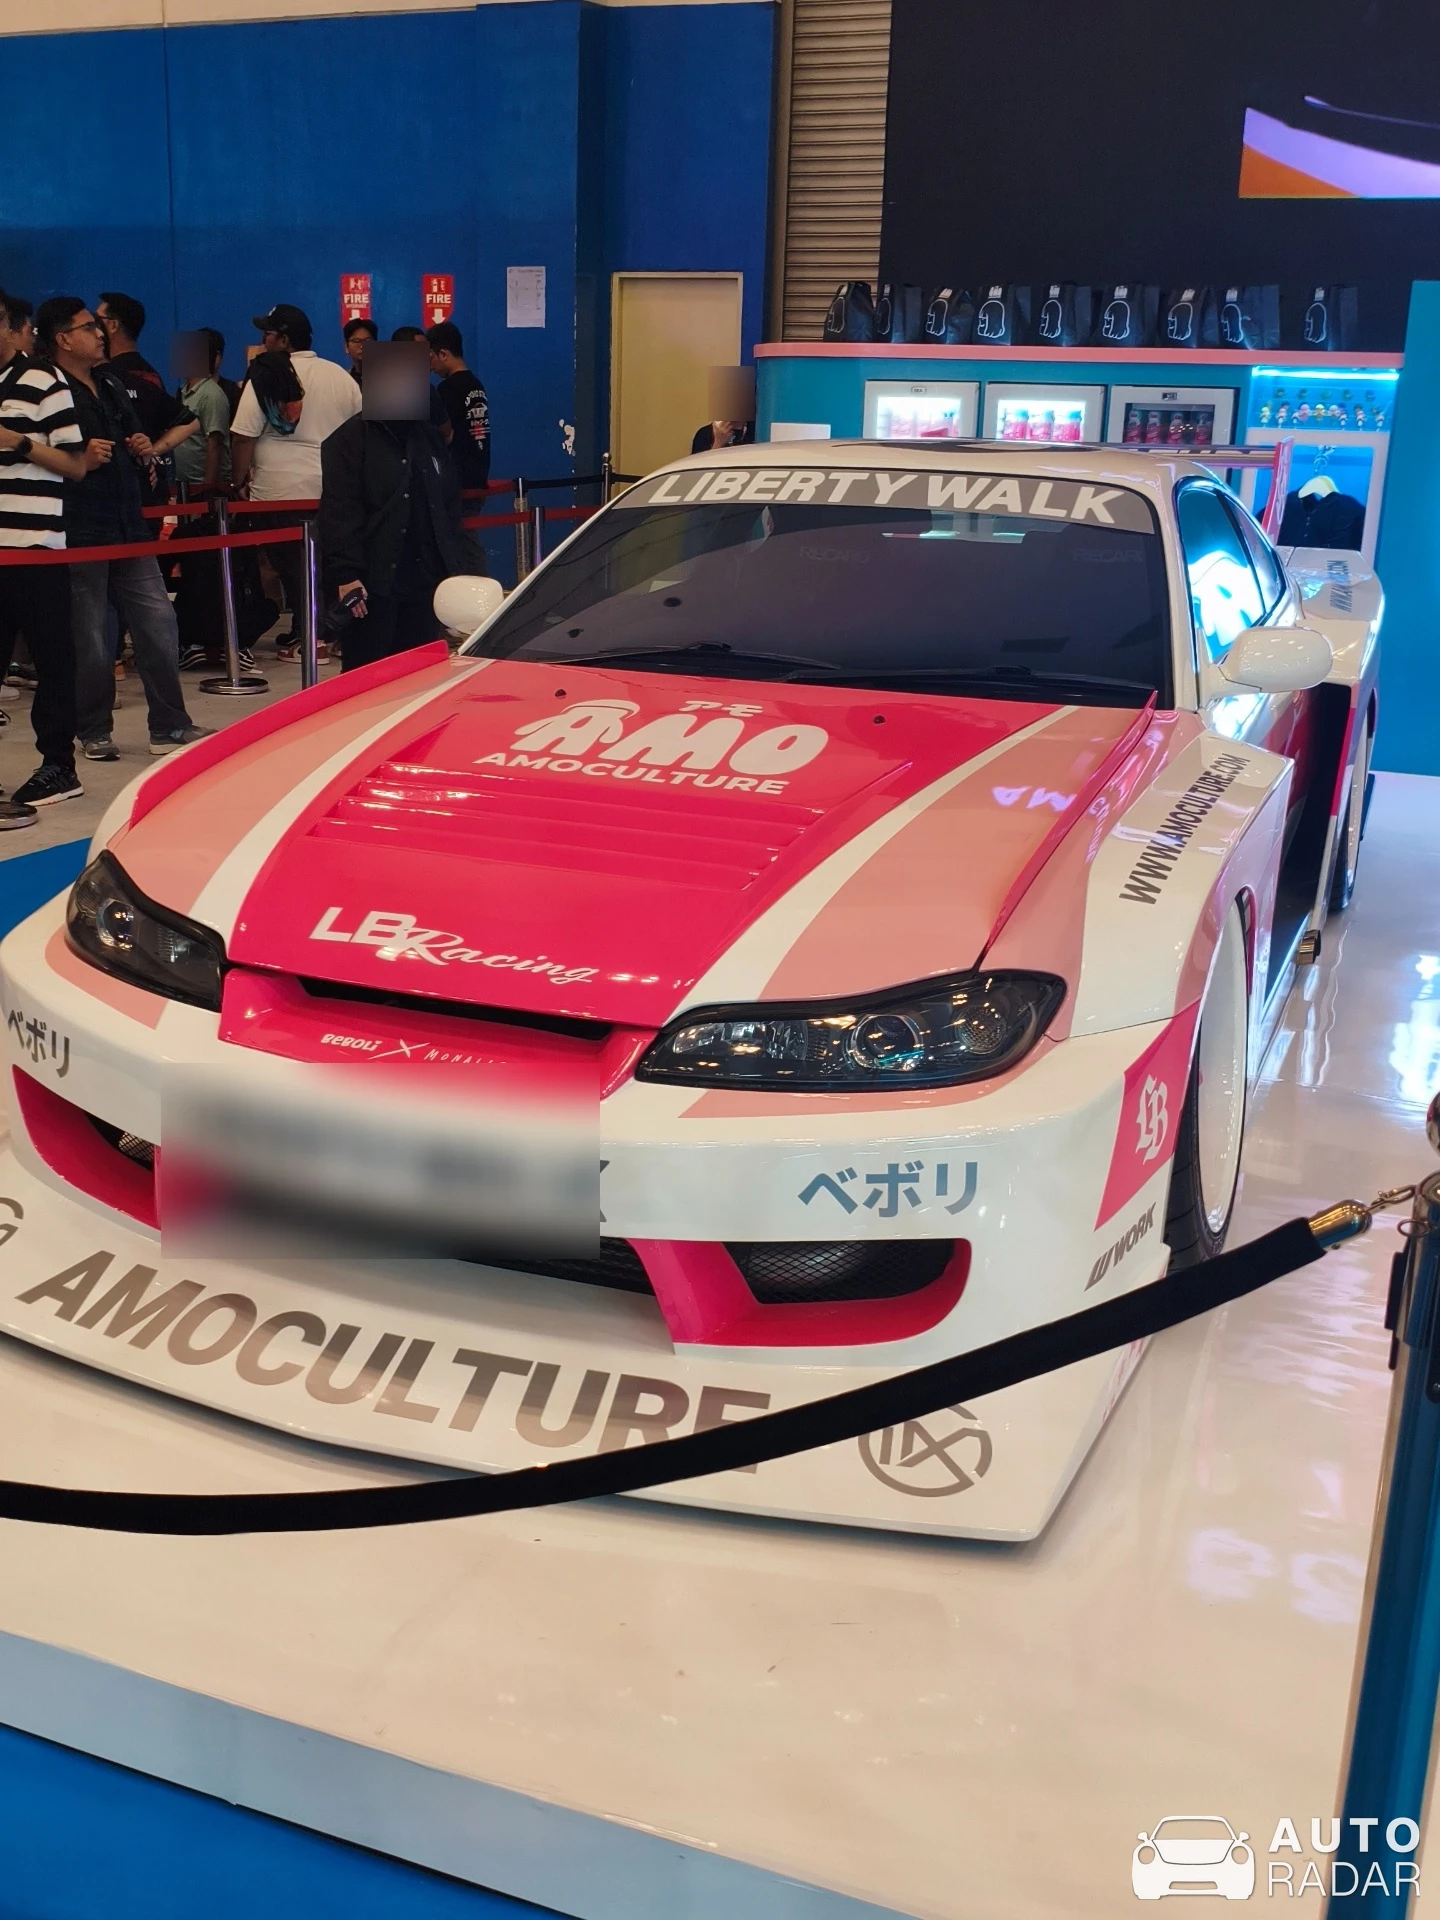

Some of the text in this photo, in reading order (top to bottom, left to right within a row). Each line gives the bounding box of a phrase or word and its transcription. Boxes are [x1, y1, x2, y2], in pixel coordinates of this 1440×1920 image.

[343, 293, 369, 304] FIRE
[425, 293, 452, 304] FIRE
[648, 470, 1125, 524] LIBERTY WALK
[509, 699, 829, 775] AMO
[472, 752, 790, 795] AMOCULTURE
[1119, 753, 1251, 905] WWW.AMOCULTURE.COM
[8, 1009, 70, 1078] ベボリ
[798, 1159, 978, 1218] ベボリ
[1113, 1201, 1156, 1267] WORK
